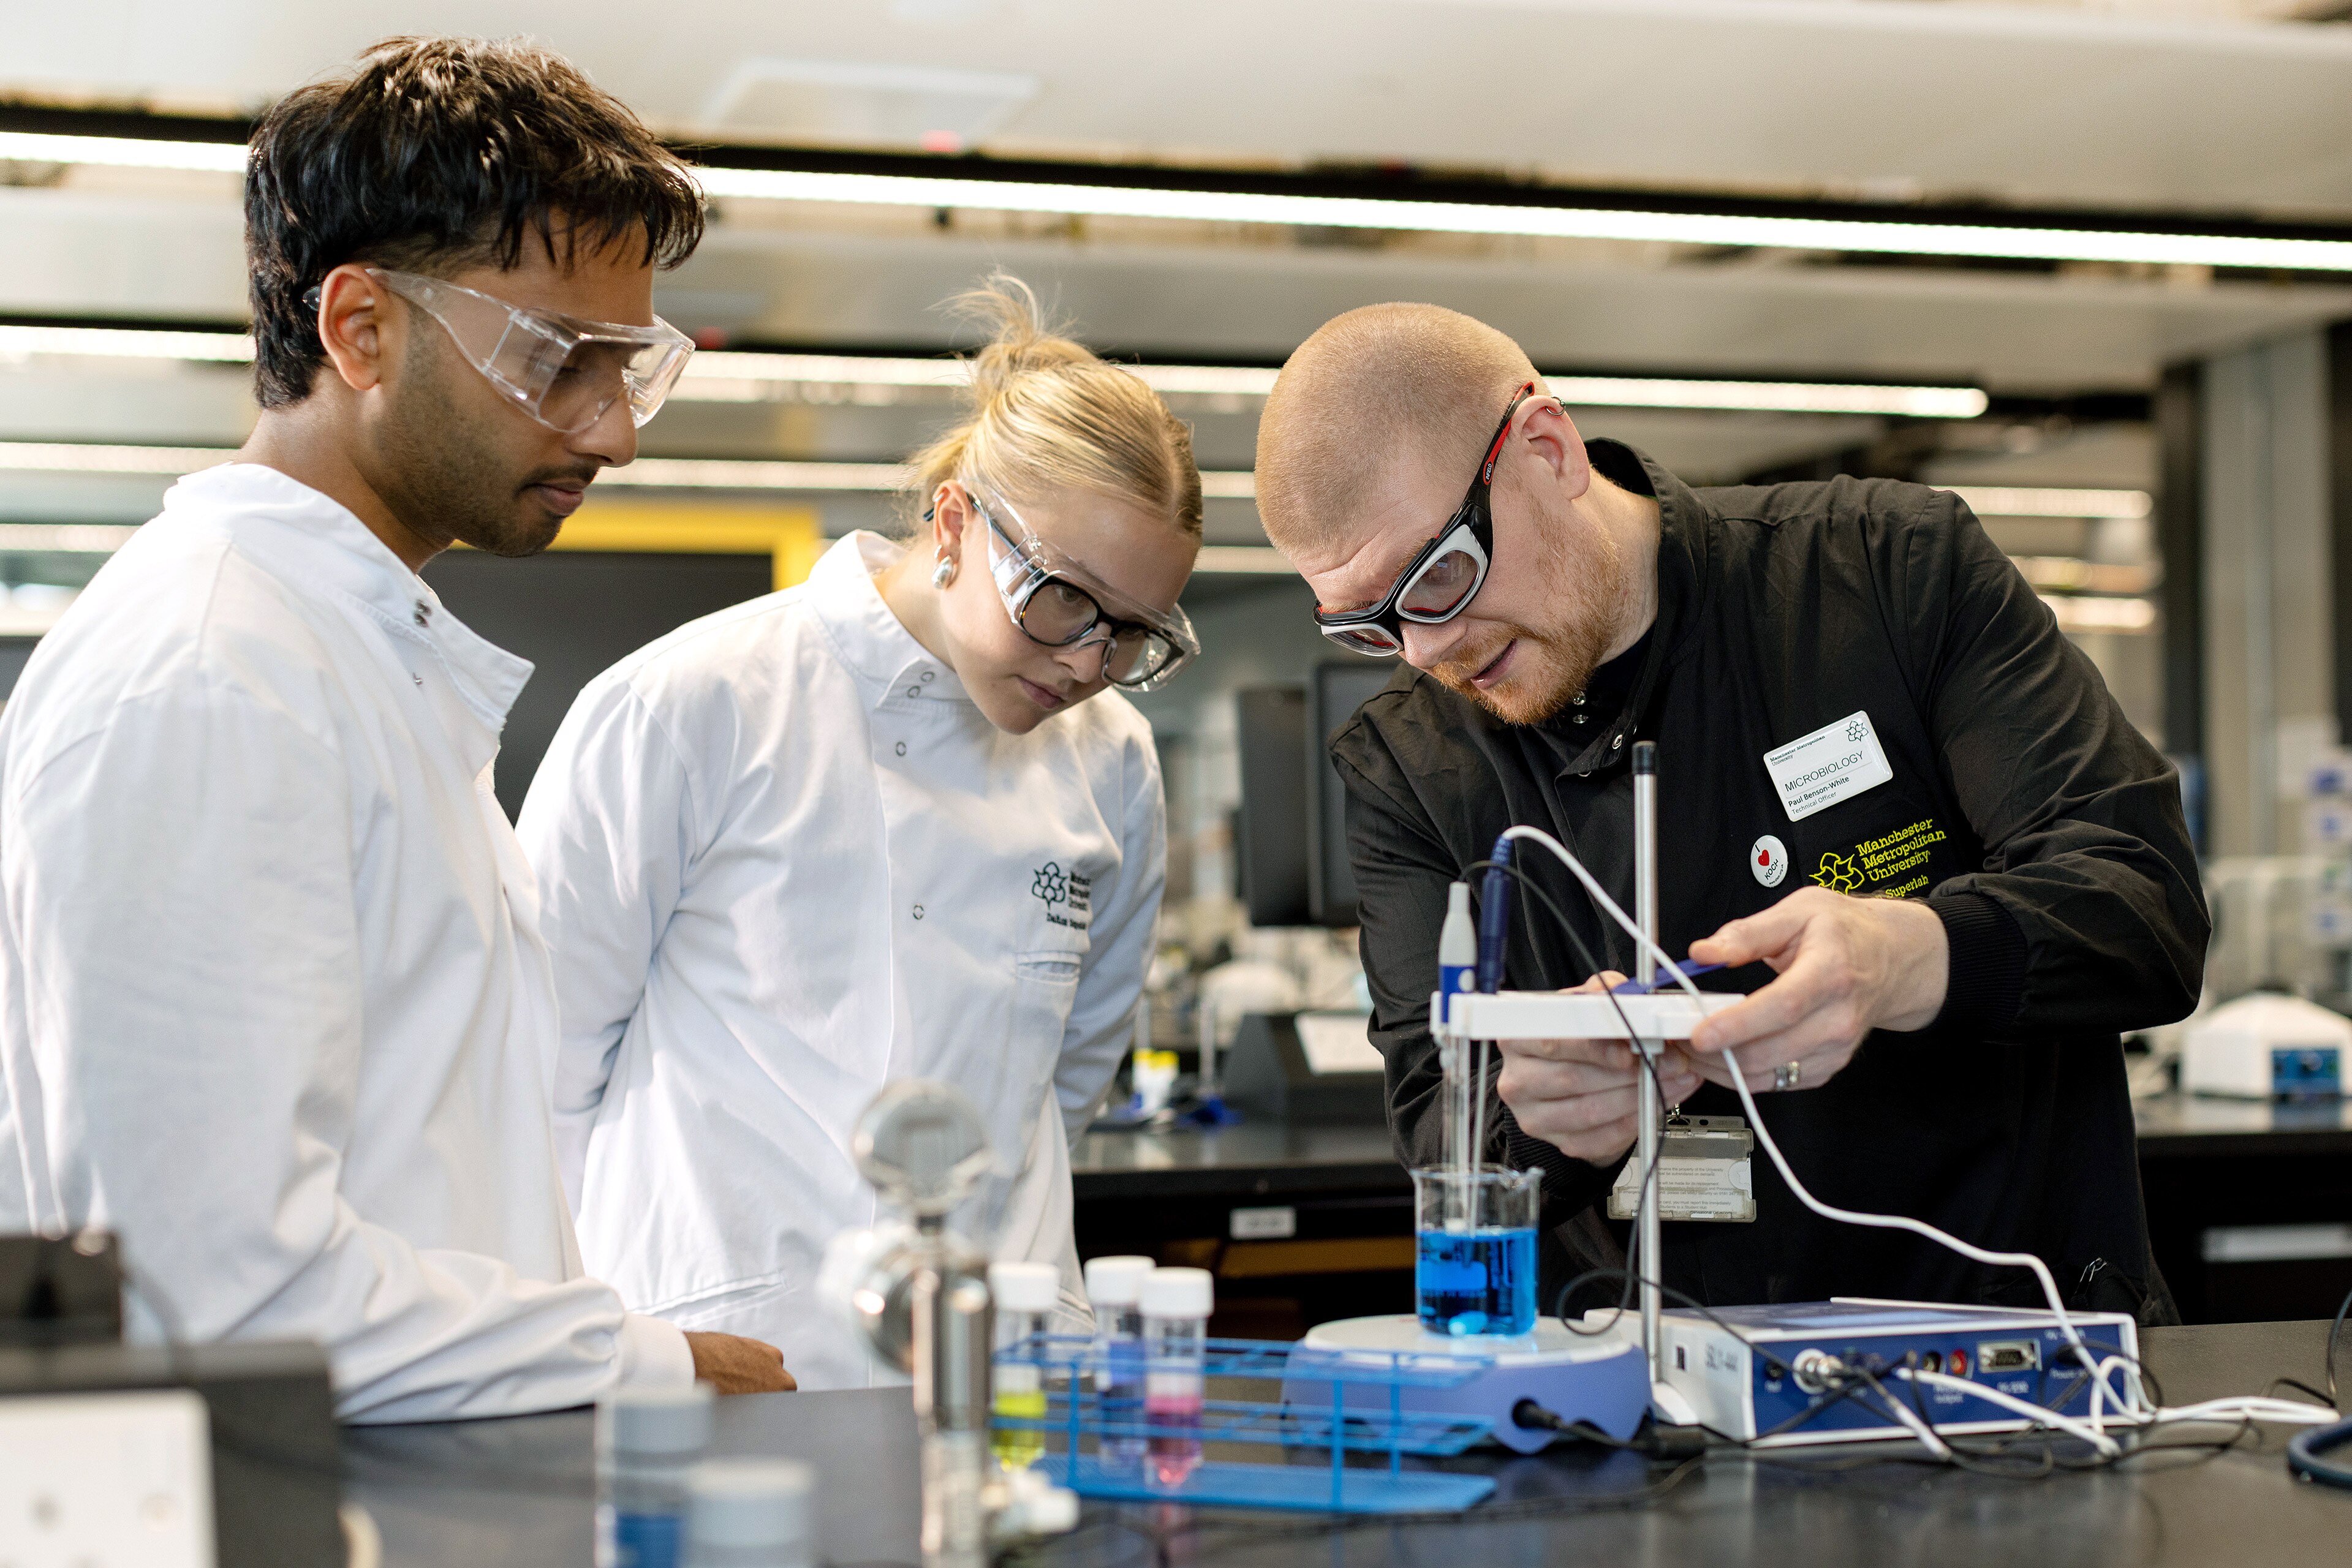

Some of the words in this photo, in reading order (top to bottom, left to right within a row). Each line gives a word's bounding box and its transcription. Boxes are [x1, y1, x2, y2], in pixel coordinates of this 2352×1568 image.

[1770, 748, 1796, 763] Manchester
[1796, 735, 1825, 751] Metropolitan
[1771, 754, 1793, 767] University
[1785, 750, 1863, 792] MICROBIOLOGY
[1788, 796, 1803, 807] Paul
[1803, 776, 1850, 801] Benson-White
[1791, 799, 1818, 815] Technical
[1818, 791, 1837, 804] Officer
[1855, 818, 1933, 857] Manchester
[1861, 829, 1946, 870] Metropolitan
[1764, 859, 1779, 880] KOCH
[1867, 850, 1931, 881] University
[1885, 874, 1929, 899] Superlab
